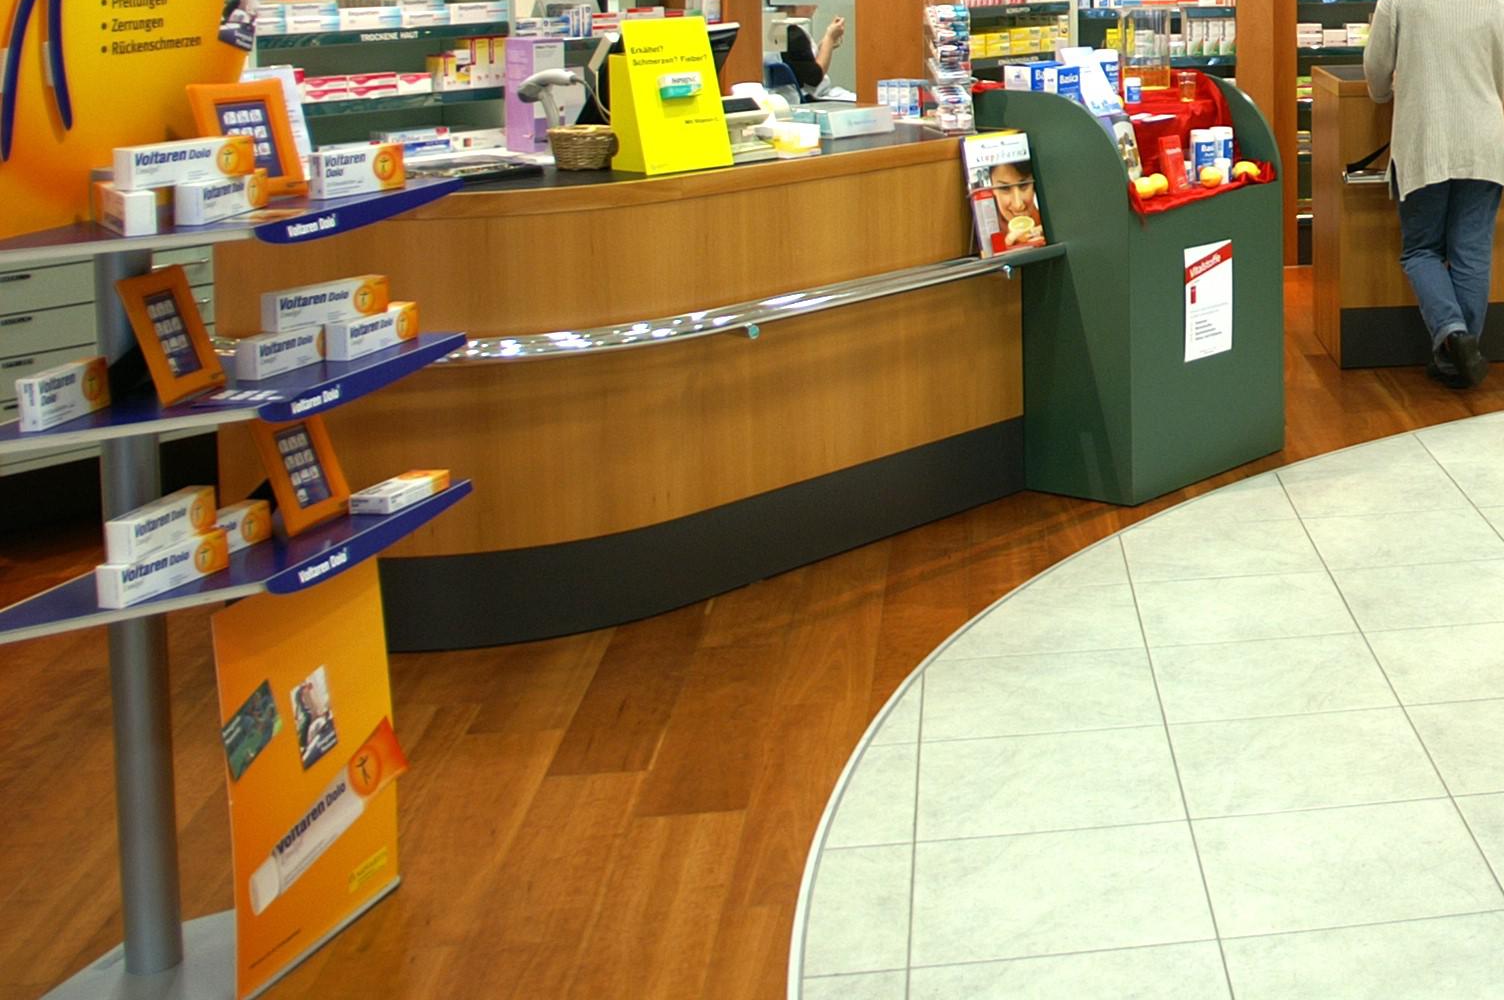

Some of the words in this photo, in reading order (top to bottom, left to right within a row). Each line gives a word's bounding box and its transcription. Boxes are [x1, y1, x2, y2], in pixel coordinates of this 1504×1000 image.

[112, 16, 164, 32] Zerrungen
[112, 35, 202, 55] Rückenschmerzen
[134, 150, 188, 167] Voltaren
[188, 147, 212, 159] Dolo
[324, 151, 366, 168] Voltaren
[325, 167, 344, 178] Dolo
[203, 179, 232, 201] Voltaren
[286, 219, 318, 238] Voltaren
[318, 213, 336, 231] Dolo
[279, 291, 327, 312] Voltaren
[328, 289, 350, 302] Dolo
[348, 319, 380, 340] Voltaren
[379, 316, 394, 330] Dolo
[258, 337, 297, 359] Voltaren
[296, 334, 315, 347] Dolo
[38, 372, 76, 395] Voltaren
[290, 394, 321, 414] Voltaren
[320, 386, 340, 404] Dolo
[134, 511, 170, 538] Voltaren
[169, 506, 187, 522] Dolo
[121, 556, 169, 583] Voltaren
[168, 550, 191, 566] Dolo
[298, 560, 329, 583] Voltaren
[328, 549, 348, 570] Dolo
[275, 799, 326, 854] Voltaren
[326, 781, 346, 807] Dolo
